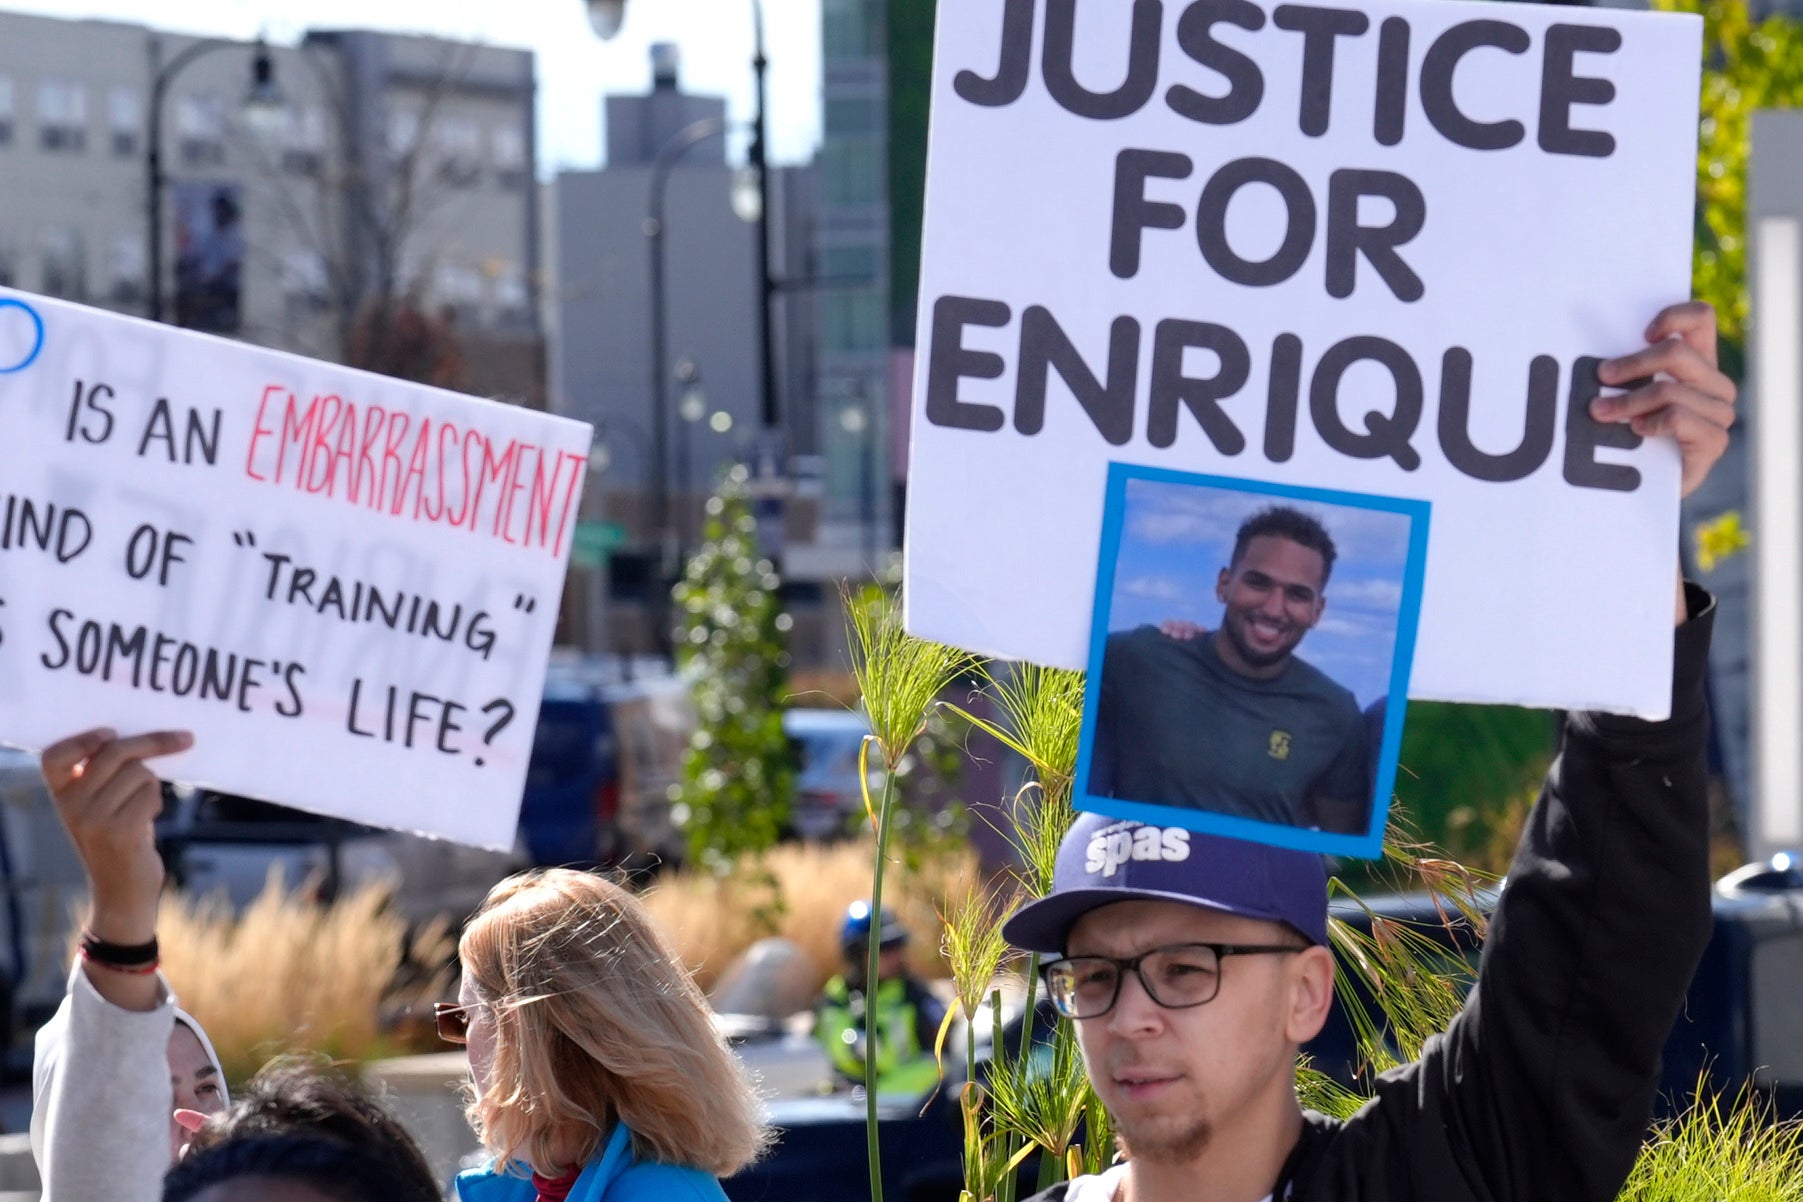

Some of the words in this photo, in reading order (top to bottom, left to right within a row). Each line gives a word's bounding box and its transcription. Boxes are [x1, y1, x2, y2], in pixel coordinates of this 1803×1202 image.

[954, 0, 1622, 158] JUSTICE
[1109, 148, 1427, 302] FOR
[65, 379, 116, 443] IS
[137, 398, 222, 466] AN
[245, 385, 588, 558] EMBARRASSMENT
[925, 294, 1653, 492] ENRIQUE
[0, 495, 92, 564] IND
[126, 523, 194, 586] OF
[40, 607, 308, 718] SOMEONE'S
[346, 678, 515, 767] LIFE?
[1085, 826, 1190, 878] spas
